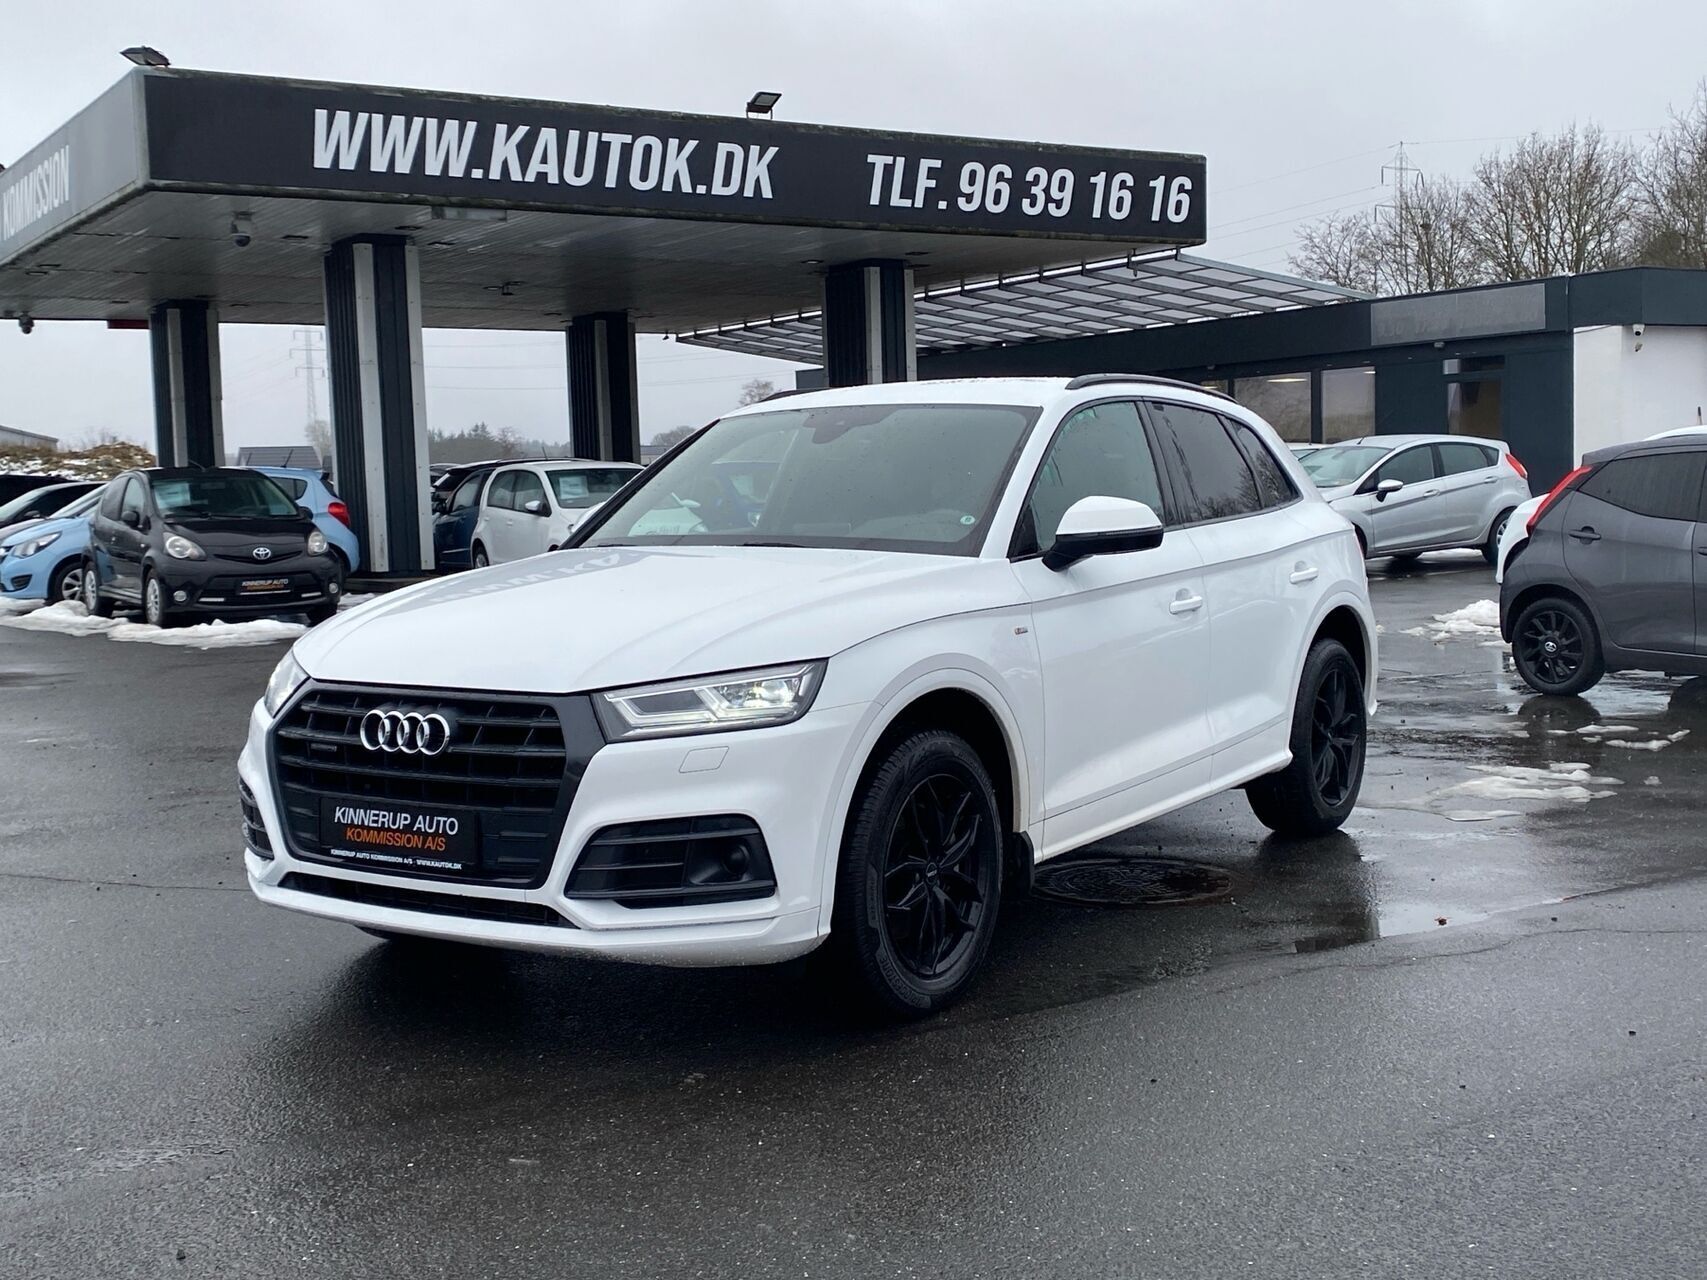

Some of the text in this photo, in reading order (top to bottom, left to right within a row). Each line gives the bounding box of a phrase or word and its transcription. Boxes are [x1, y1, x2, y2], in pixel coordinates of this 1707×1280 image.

[314, 109, 779, 199] WWW.KAUTOK.DK
[3, 144, 70, 241] KOMMISSION
[867, 155, 1192, 222] TLF. 96 39 16 16
[334, 806, 459, 835] KINNERUP AUTO
[346, 827, 446, 851] KOMMISSION A/S
[356, 852, 370, 860] AUTO
